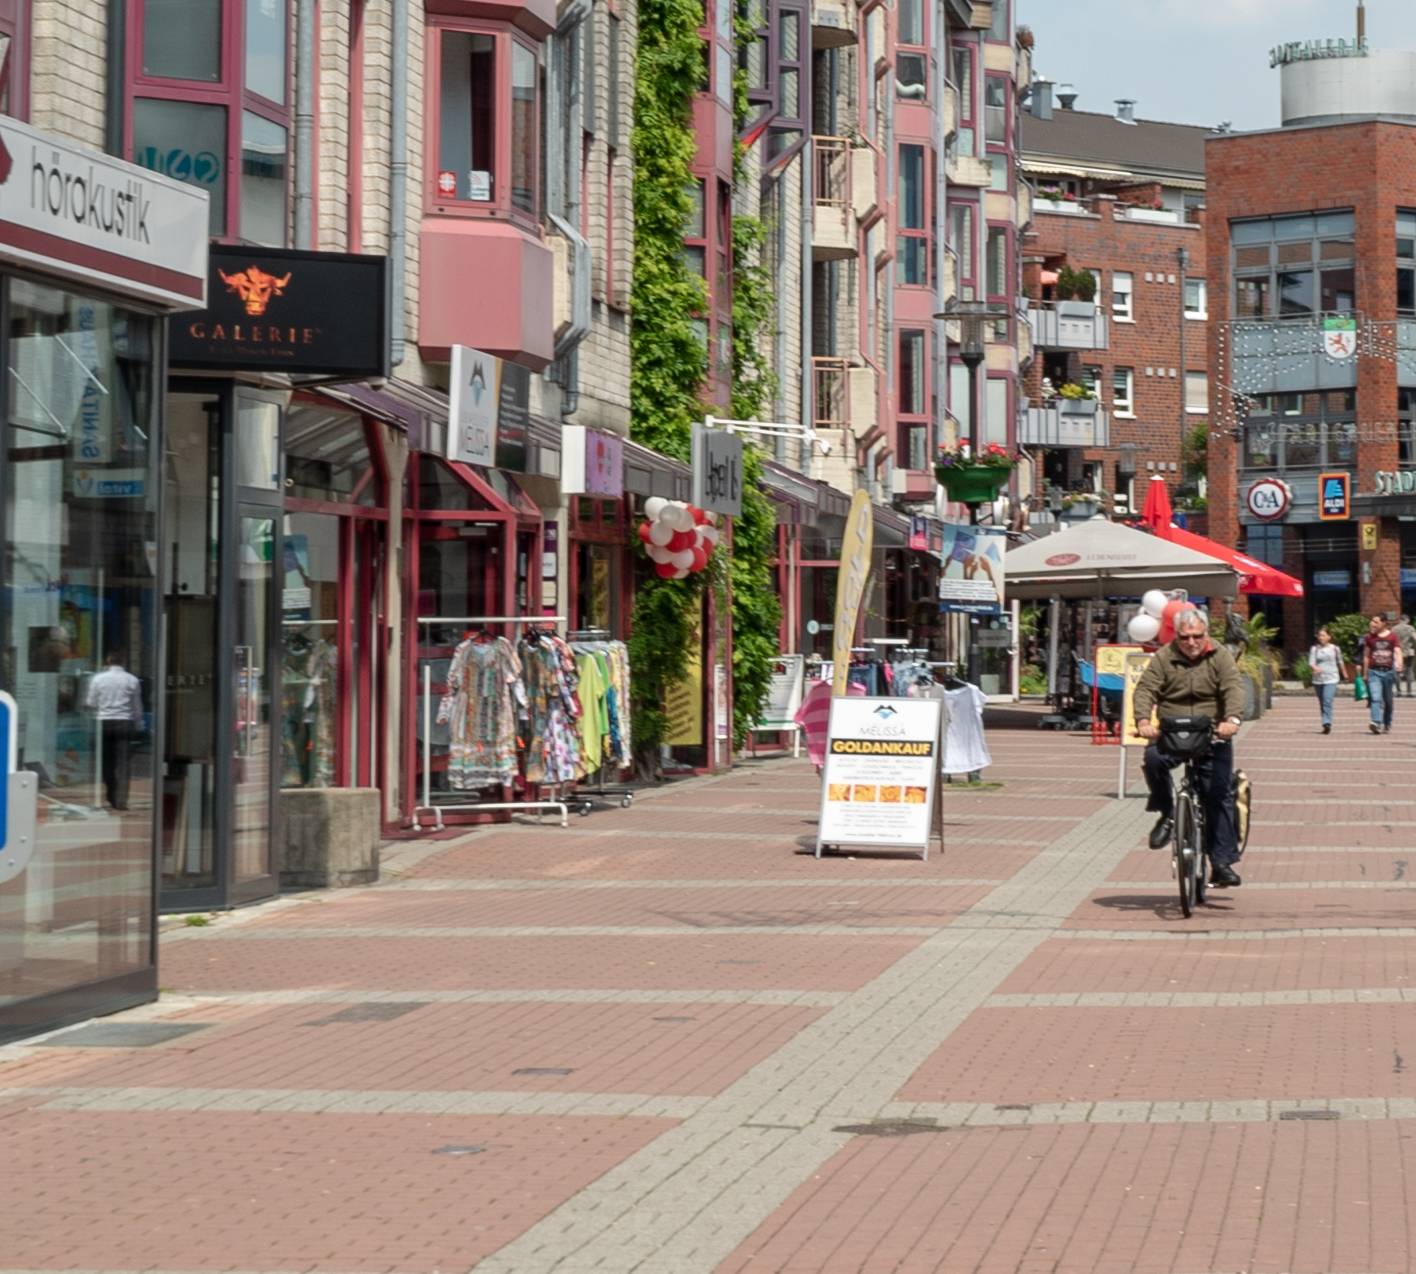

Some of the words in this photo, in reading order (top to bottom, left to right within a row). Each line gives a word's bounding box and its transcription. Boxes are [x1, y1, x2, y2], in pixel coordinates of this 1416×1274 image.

[31, 145, 151, 244] hörakustik
[189, 322, 314, 344] GALERIE
[1253, 490, 1280, 509] C&A
[832, 741, 931, 754] GOLDANKAUF
